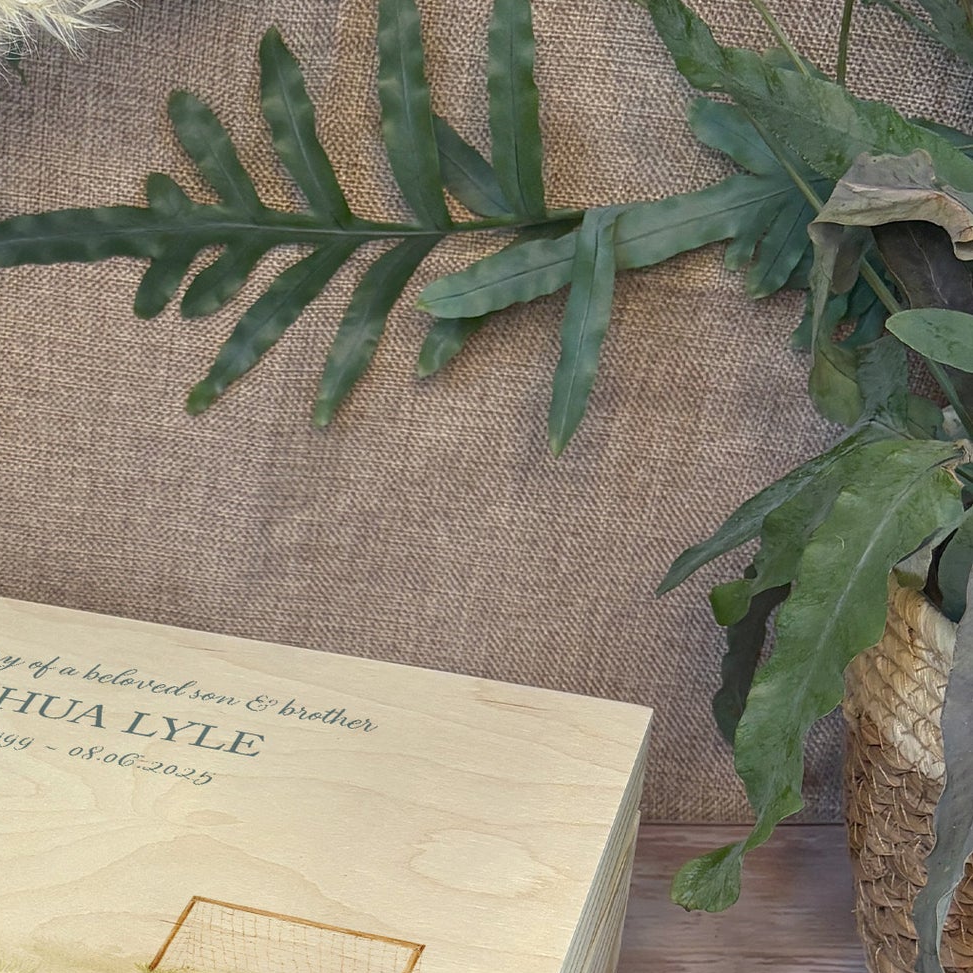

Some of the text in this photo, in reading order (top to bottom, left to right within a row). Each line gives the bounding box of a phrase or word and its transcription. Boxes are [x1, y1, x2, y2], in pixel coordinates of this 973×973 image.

[28, 656, 56, 679] of
[59, 664, 78, 676] a
[82, 663, 185, 697] beloved
[188, 686, 242, 706] son
[245, 694, 278, 712] &
[277, 698, 379, 733] brother
[121, 711, 265, 757] LYLE
[68, 745, 216, 786] 08.06.2025
